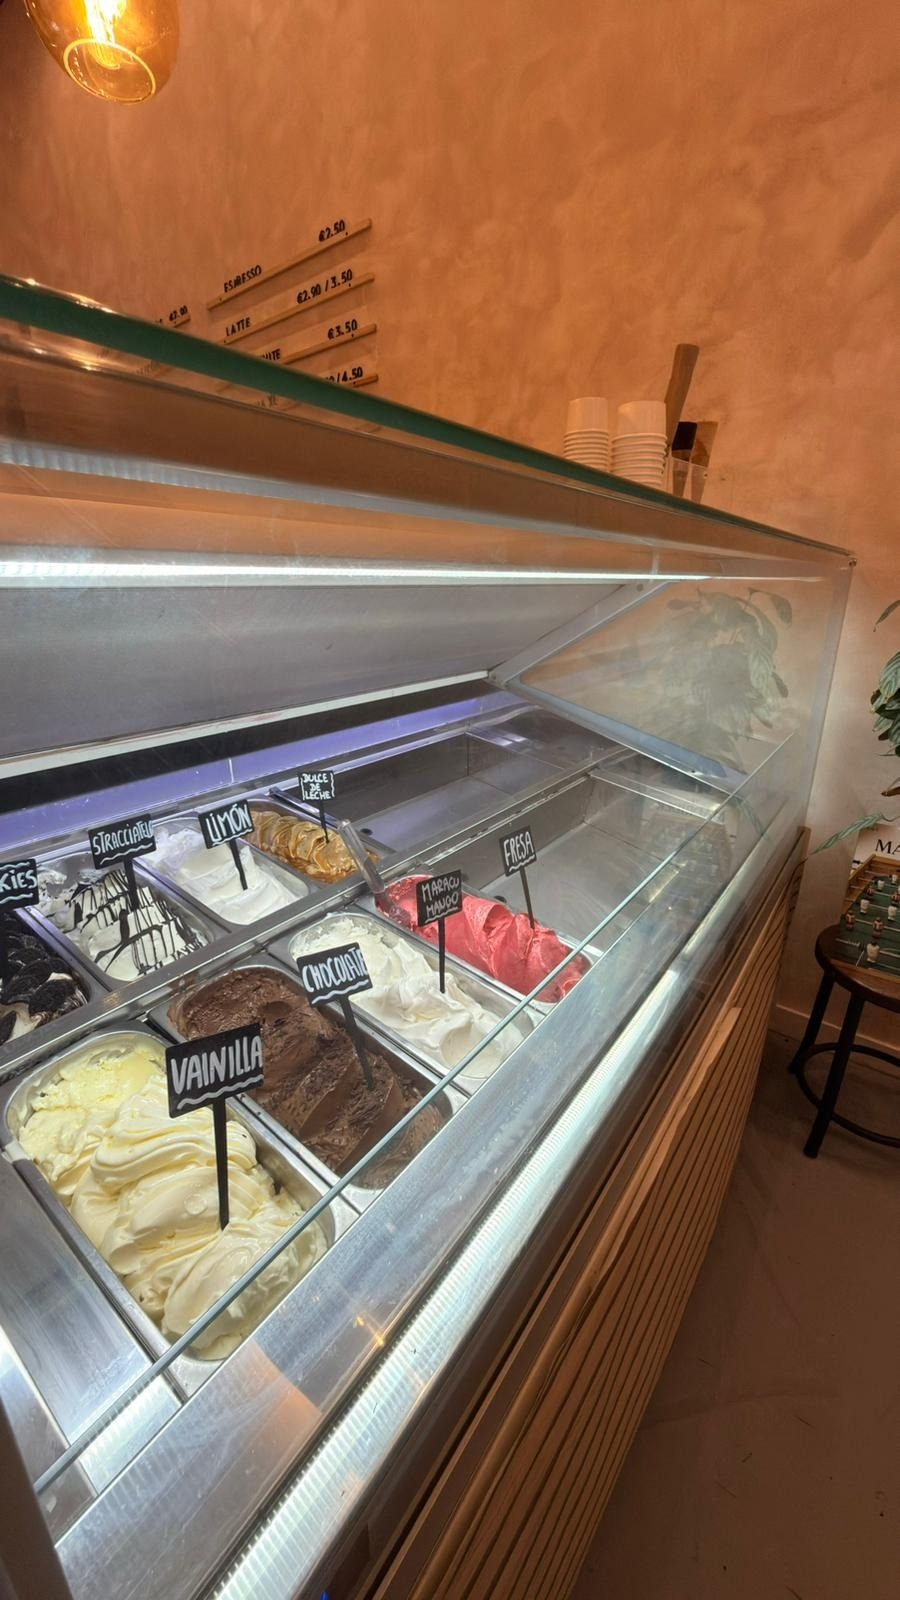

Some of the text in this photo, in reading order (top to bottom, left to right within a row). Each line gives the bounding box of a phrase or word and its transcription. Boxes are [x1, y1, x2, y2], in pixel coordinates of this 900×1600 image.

[223, 219, 346, 293] ESPRESSO €2.50
[225, 316, 251, 337] LATTE
[327, 318, 358, 340] €3.50
[302, 773, 328, 783] DULCE
[309, 782, 321, 792] DE
[305, 790, 331, 800] LECHE
[205, 803, 252, 842] LIMÓN
[503, 831, 535, 866] FRESA
[302, 946, 369, 993] CHOCOLATE
[170, 1035, 263, 1095] VAINILLA
